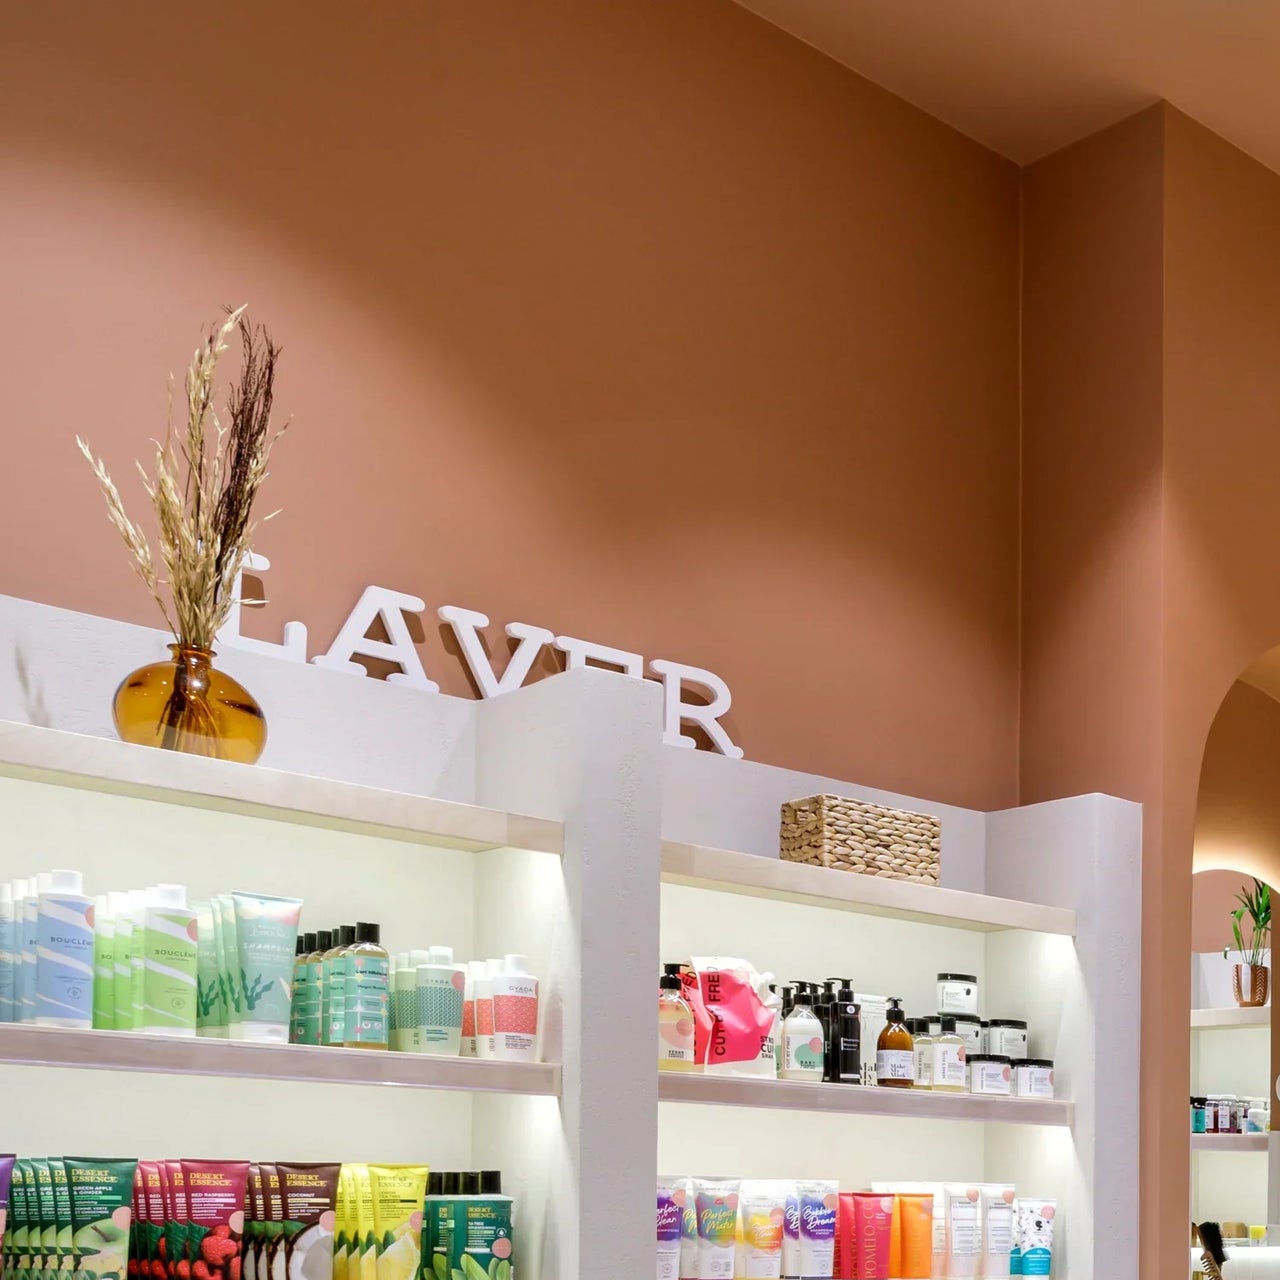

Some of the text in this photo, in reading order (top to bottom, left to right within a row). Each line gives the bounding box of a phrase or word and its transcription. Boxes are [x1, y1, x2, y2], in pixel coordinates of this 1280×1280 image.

[708, 967, 726, 1056] CUT FRED
[656, 1203, 679, 1214] erfect
